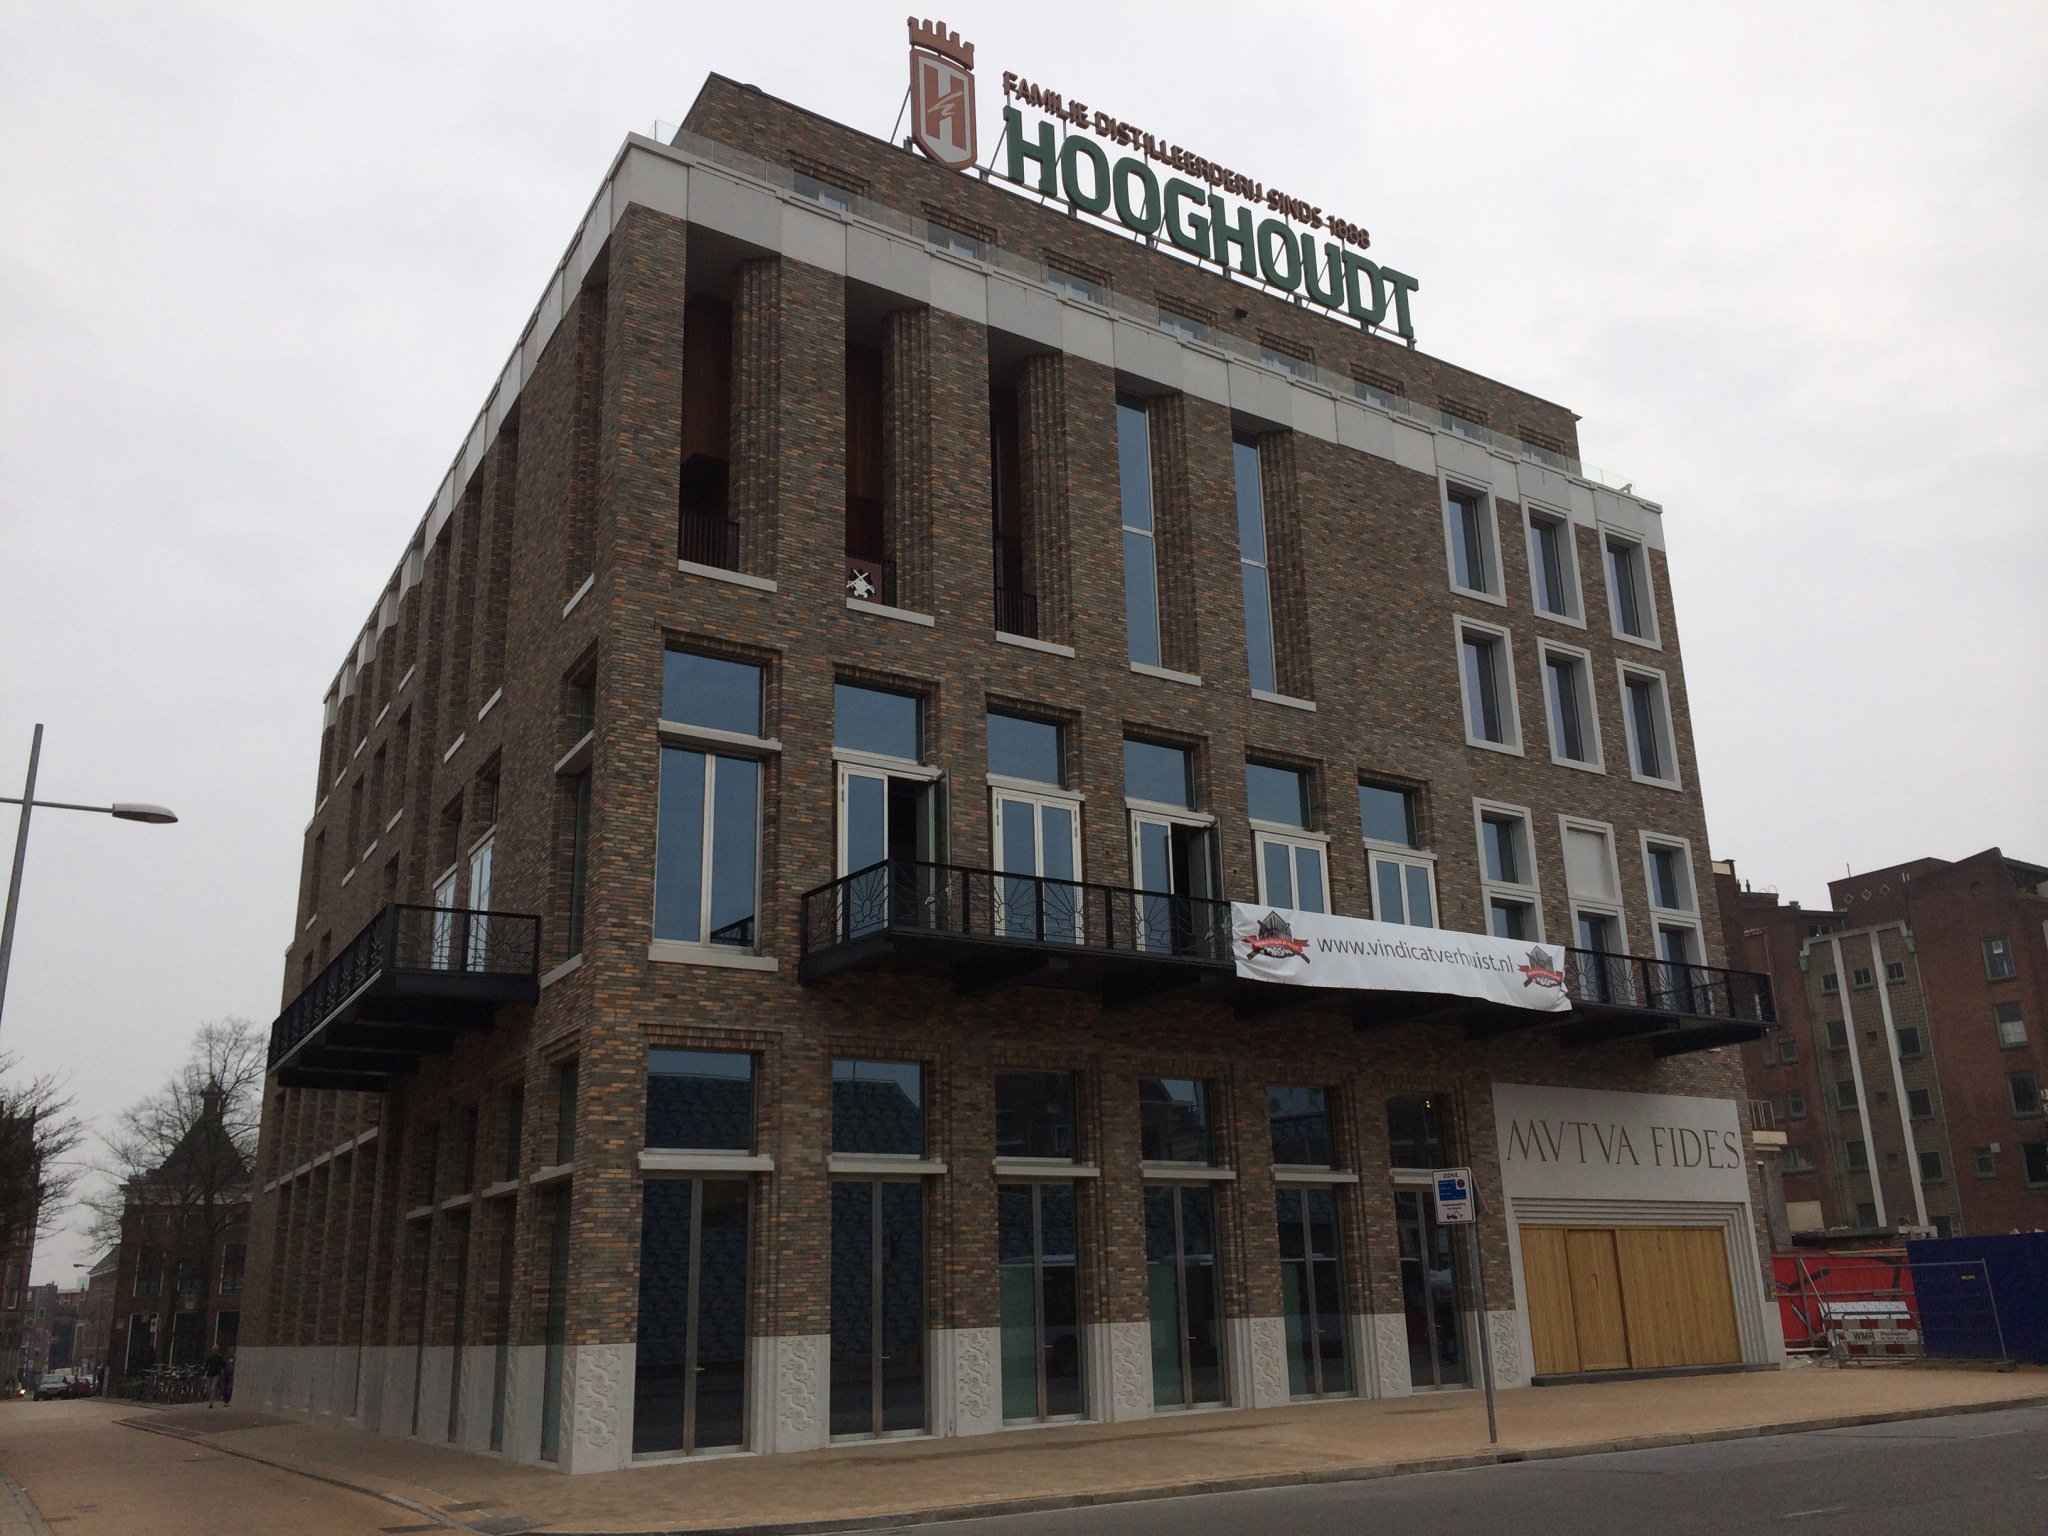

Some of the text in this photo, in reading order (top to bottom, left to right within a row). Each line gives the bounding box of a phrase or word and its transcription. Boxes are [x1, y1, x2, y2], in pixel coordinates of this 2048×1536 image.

[1002, 70, 1371, 250] FAMILIE DISTILLEERDERIJ SINDS 1888
[1003, 104, 1419, 339] HOOGHOUDT
[1316, 937, 1515, 974] www.vindicatverhuist.nl
[1506, 1118, 1741, 1170] MVTVA FIDES
[1852, 1331, 1876, 1341] WMR
